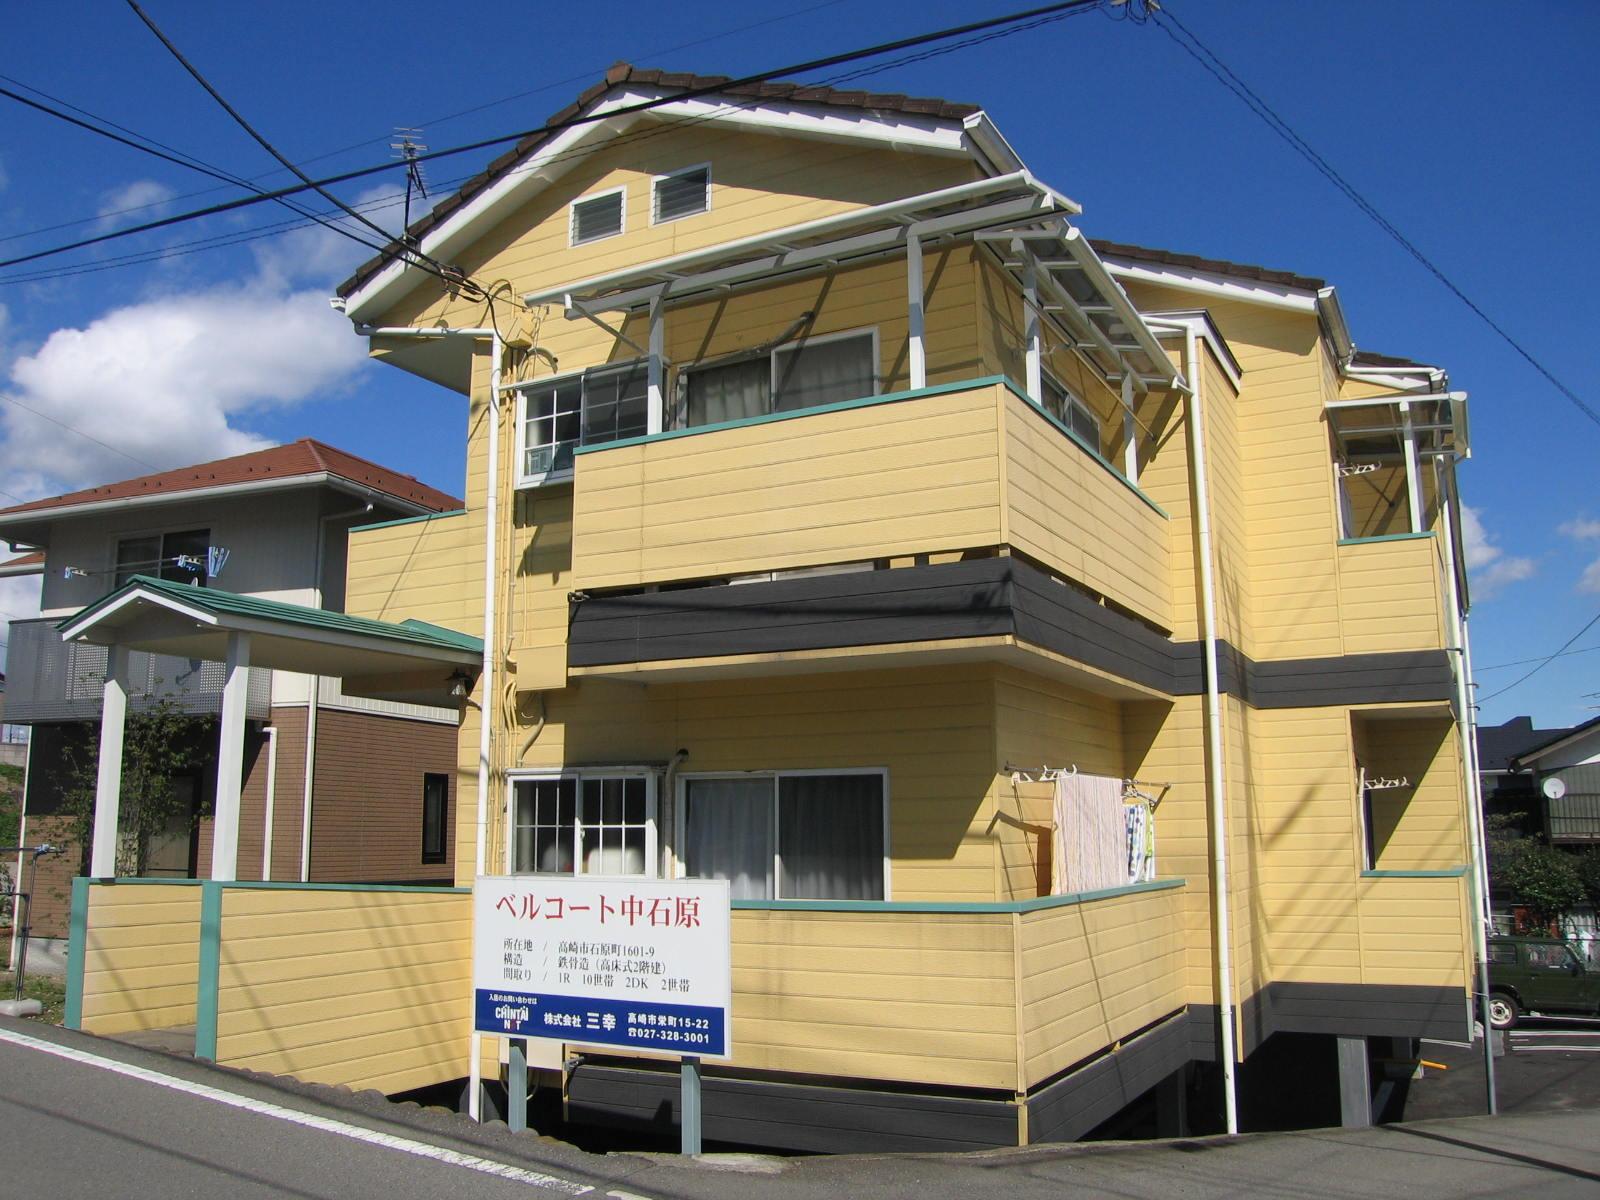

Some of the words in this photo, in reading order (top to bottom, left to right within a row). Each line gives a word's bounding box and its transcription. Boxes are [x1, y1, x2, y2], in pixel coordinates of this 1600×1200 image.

[496, 893, 701, 928] ベルコート中石原
[504, 939, 533, 953] 所在地
[504, 954, 523, 966] 構造
[503, 968, 532, 981] 間取り
[626, 978, 649, 989] 2DK
[661, 979, 690, 993] 2世帯
[504, 1019, 522, 1031] NT
[544, 1012, 581, 1028] 株式会社
[587, 1012, 616, 1031] 三幸
